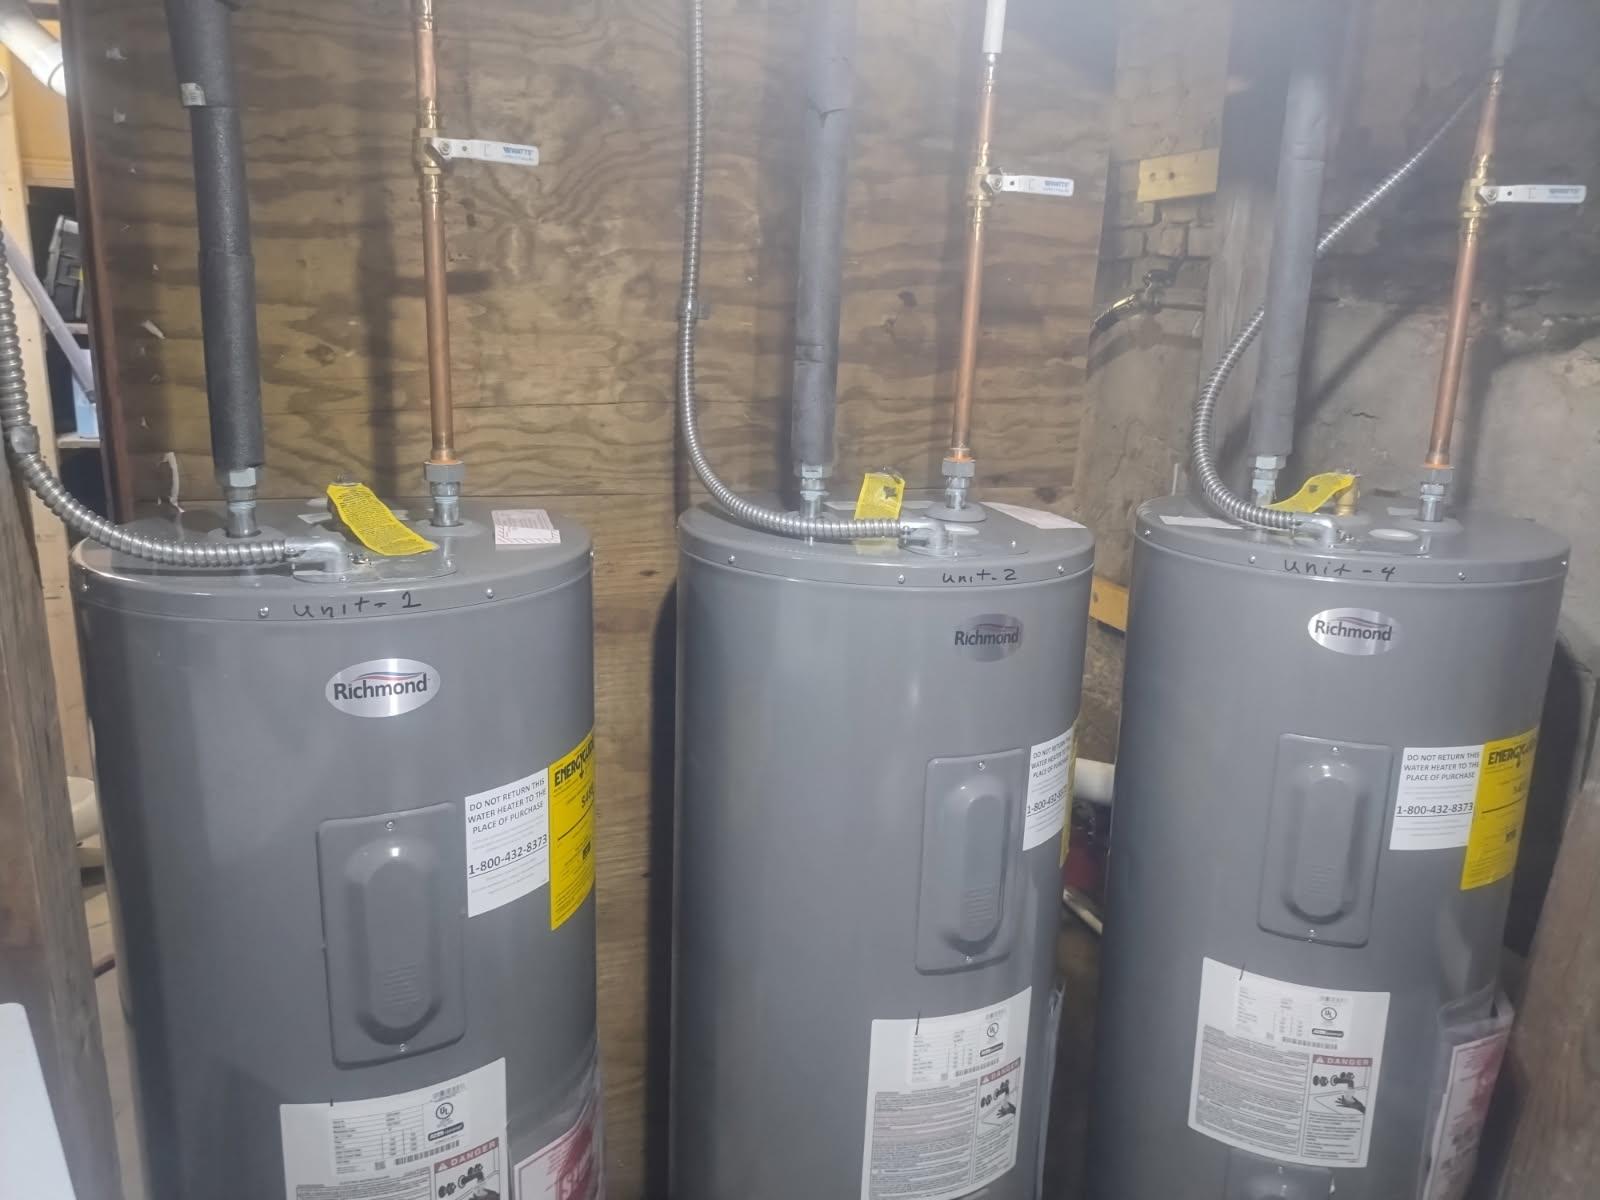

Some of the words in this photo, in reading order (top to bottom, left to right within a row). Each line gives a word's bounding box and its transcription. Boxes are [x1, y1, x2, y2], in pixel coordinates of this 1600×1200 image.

[954, 625, 1020, 646] Richmond
[1314, 619, 1393, 641] Richmond
[333, 673, 428, 701] Richmond
[1431, 763, 1457, 771] HEATER
[1438, 753, 1465, 761] RETURN
[1441, 772, 1475, 781] PURCHASE
[467, 809, 496, 823] WATER
[497, 799, 524, 815] HEATER
[525, 794, 534, 804] TO
[535, 788, 547, 799] THE
[470, 802, 483, 812] DO
[484, 796, 502, 808] NOT
[502, 785, 531, 801] RETURN
[531, 778, 545, 790] THIS
[472, 821, 497, 834] PLACE
[498, 815, 509, 826] OF
[510, 800, 544, 822] PURCHASE
[1396, 802, 1474, 815] 1-800-432-8373
[468, 834, 548, 875] 1-800-432-8373
[1327, 1057, 1369, 1066] DANGER
[450, 1140, 496, 1167] DANGER
